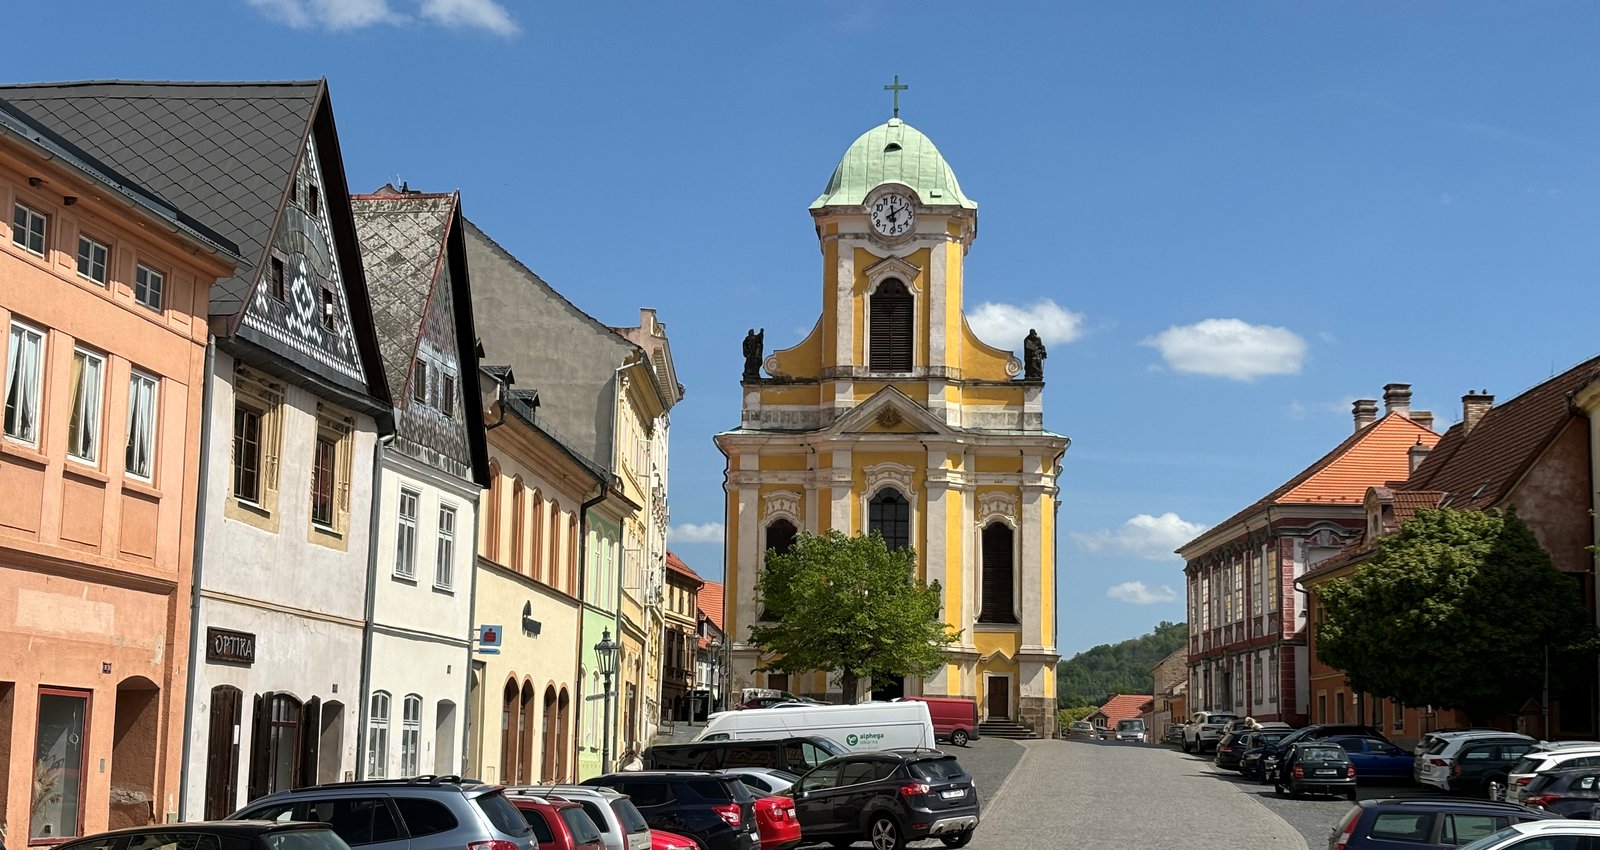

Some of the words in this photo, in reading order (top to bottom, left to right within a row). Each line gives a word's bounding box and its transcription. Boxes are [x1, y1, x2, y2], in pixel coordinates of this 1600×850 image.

[890, 196, 897, 204] 12
[876, 204, 883, 212] 10
[904, 202, 910, 211] 2
[873, 212, 878, 220] 9
[908, 211, 912, 220] 3
[876, 220, 880, 228] 8
[890, 226, 895, 234] 6
[216, 634, 252, 658] OPTIKA
